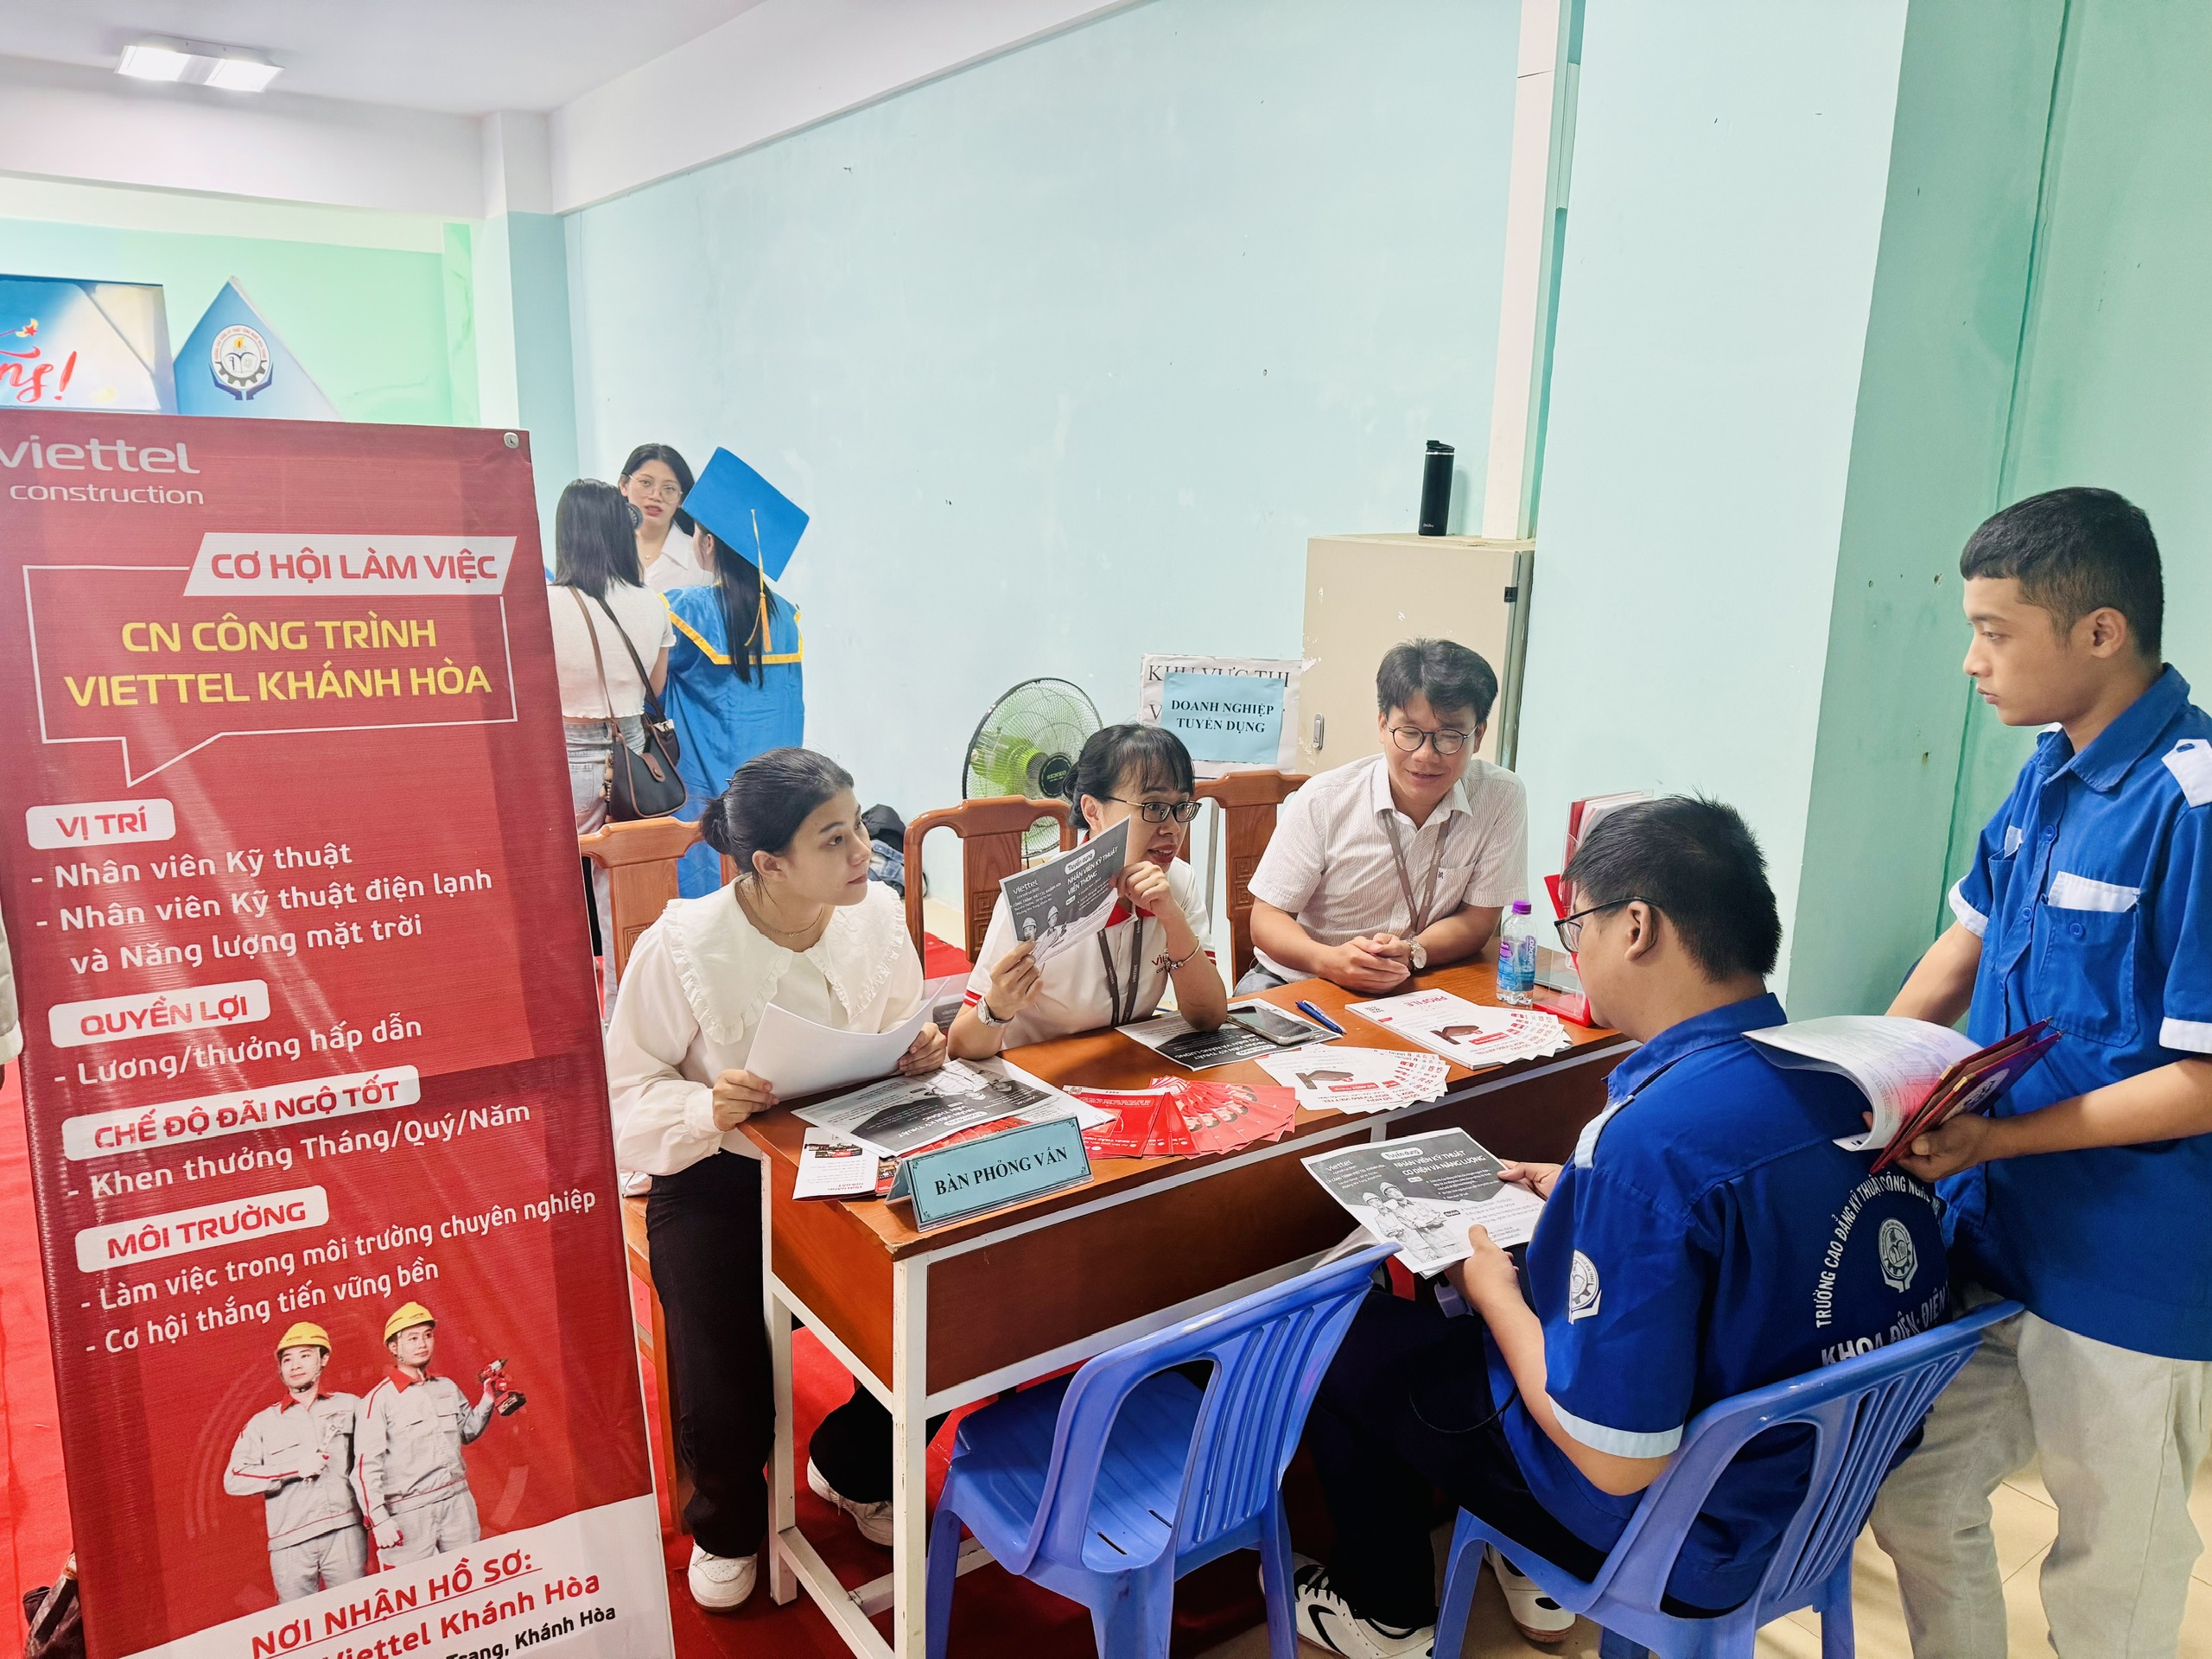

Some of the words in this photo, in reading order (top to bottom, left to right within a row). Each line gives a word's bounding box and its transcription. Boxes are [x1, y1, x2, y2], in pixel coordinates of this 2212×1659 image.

[0, 434, 200, 475] viettel
[9, 483, 204, 505] construction
[211, 549, 263, 580] CƠ
[270, 546, 332, 584] HỘI
[340, 546, 418, 580] LÀM
[423, 548, 499, 584] VIỆC
[122, 621, 181, 652] CN
[192, 612, 308, 652] CÔNG
[315, 610, 437, 649] TRÌNH
[64, 672, 251, 707] VIETTEL
[258, 660, 402, 701] KHÁNH
[408, 657, 493, 696] HÒA
[1171, 700, 1219, 712] DOANH
[1222, 702, 1274, 717] NGHIỆP
[1177, 716, 1223, 731] TUYỂN
[1226, 721, 1265, 734] DỤNG
[56, 815, 89, 842] VỊ
[94, 805, 147, 835] TRÍ
[55, 858, 142, 888] Nhân
[149, 852, 216, 880] viên
[226, 849, 265, 880] Kỹ
[273, 844, 353, 870] thuật
[60, 900, 146, 932] Nhân
[155, 894, 222, 922] viên
[230, 887, 269, 921] Kỹ
[278, 881, 357, 912] thuật
[365, 874, 425, 903] điện
[433, 869, 493, 896] lạnh
[69, 948, 110, 975] và
[120, 937, 203, 971] Năng
[212, 926, 297, 960] lượng
[306, 918, 365, 947] mặt
[371, 914, 423, 940] trời
[79, 996, 194, 1036] QUYỀN
[200, 995, 249, 1021] LỢI
[1403, 995, 1448, 1007] PROFILE
[78, 1035, 302, 1084] Lương/thưởng
[310, 1021, 365, 1052] hấp
[372, 1012, 423, 1043] dẫn
[94, 1110, 158, 1149] CHẾ
[162, 1104, 210, 1141] ĐỘ
[215, 1096, 269, 1128] ĐÃI
[275, 1084, 338, 1118] NGỘ
[343, 1075, 399, 1108] TỐT
[91, 1166, 174, 1199] Khen
[182, 1146, 294, 1182] thưởng
[300, 1103, 531, 1161] Tháng/Quý/Năm
[934, 1172, 970, 1196] BÀN
[973, 1158, 1032, 1185] PHỎNG
[1033, 1147, 1068, 1166] VẤN
[1848, 1189, 1863, 1214] KỸ
[1879, 1171, 1906, 1192] CÔNG
[105, 1223, 171, 1259] MÔI
[174, 1198, 307, 1242] TRƯỜNG
[1831, 1205, 1857, 1242] ĐẲNG
[99, 1279, 158, 1312] Làm
[164, 1266, 218, 1299] việc
[224, 1250, 296, 1285] trong
[303, 1236, 349, 1266] môi
[354, 1220, 434, 1260] trường
[440, 1200, 518, 1242] chuyên
[523, 1185, 598, 1224] nghiệp
[1824, 1240, 1844, 1268] CAO
[105, 1325, 139, 1353] Cơ
[147, 1317, 189, 1347] hội
[194, 1300, 271, 1333] thắng
[277, 1274, 327, 1312] tiến
[332, 1267, 393, 1305] vững
[397, 1255, 439, 1285] bền
[1813, 1271, 1836, 1328] TRƯỜNG
[1821, 1332, 1884, 1366] KHOA
[251, 1618, 312, 1659] NƠI
[324, 1586, 419, 1633] NHẬN
[429, 1557, 474, 1600] HỒ
[483, 1548, 534, 1586] SƠ:
[441, 1593, 535, 1640] Khánh
[544, 1574, 601, 1604] Hòa
[514, 1618, 575, 1649] Khánh
[581, 1605, 617, 1628] Hòa
